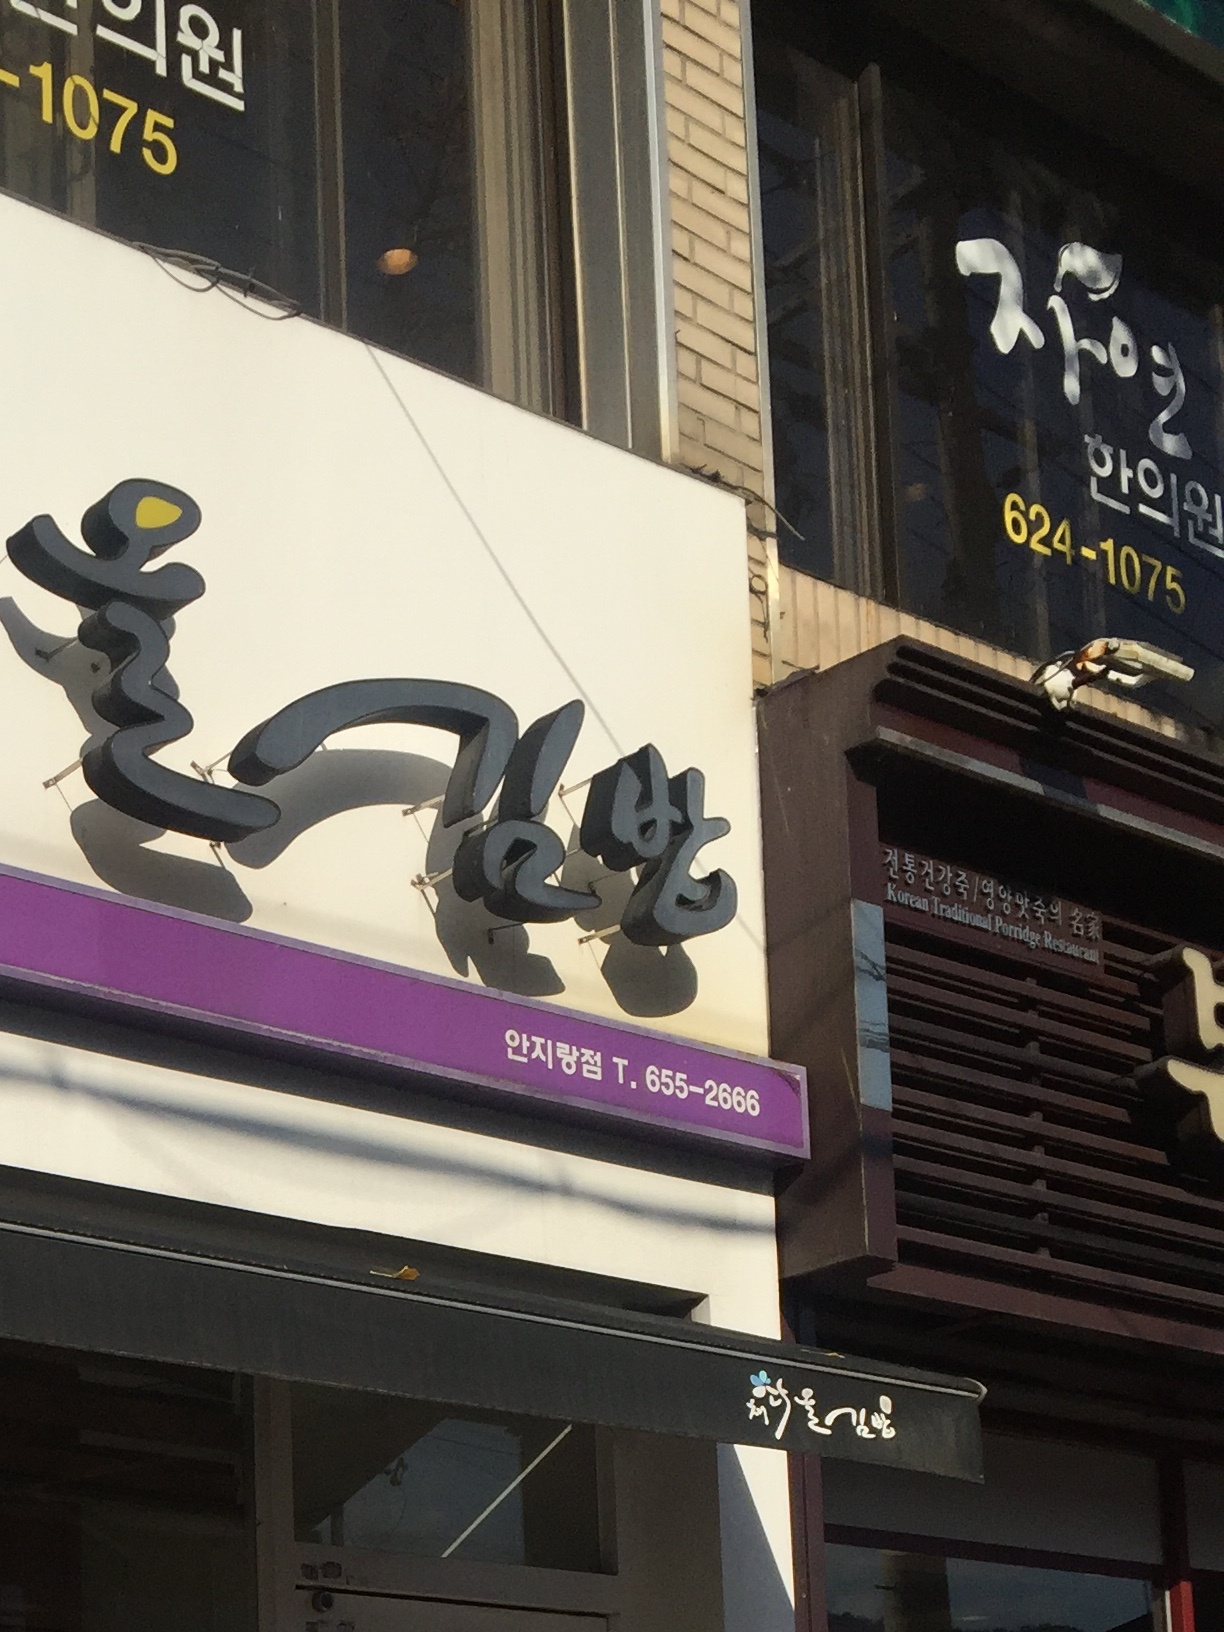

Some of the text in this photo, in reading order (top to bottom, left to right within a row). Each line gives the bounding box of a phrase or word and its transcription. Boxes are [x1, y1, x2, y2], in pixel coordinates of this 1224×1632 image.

[1084, 434, 1224, 557] 한의원
[1004, 492, 1186, 614] 624-1075
[886, 882, 1100, 965] Korean Traditional Porridge Restaurant
[504, 1029, 760, 1117] 안지랑점 T. 655-2666
